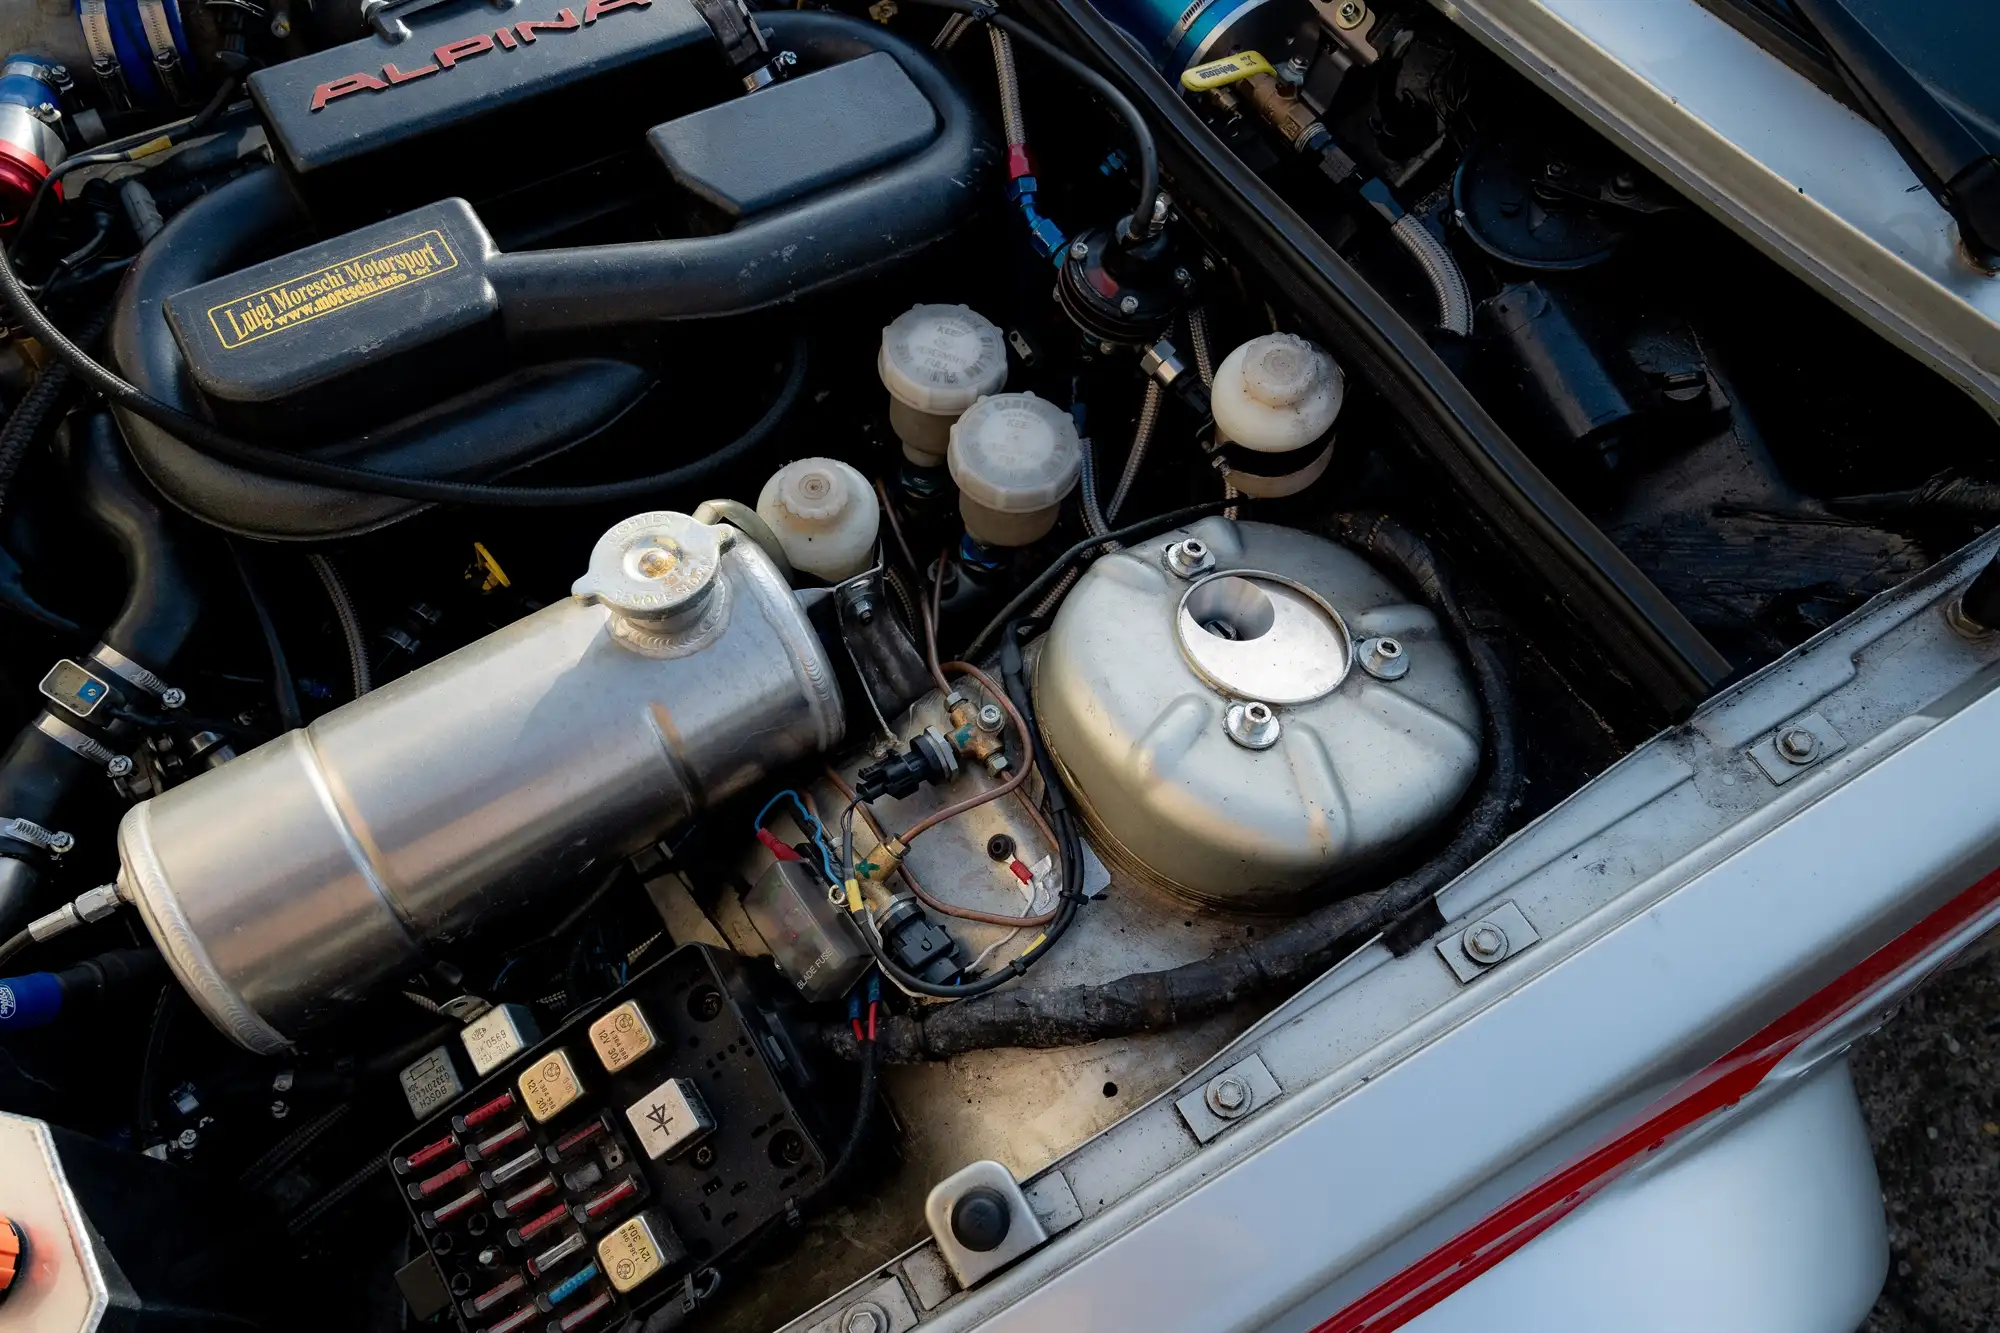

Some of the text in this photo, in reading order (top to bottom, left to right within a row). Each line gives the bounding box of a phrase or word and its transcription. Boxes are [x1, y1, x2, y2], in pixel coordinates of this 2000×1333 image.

[311, 0, 650, 111] ALPINA
[224, 242, 441, 341] Luigi Moreschi Motorsport
[274, 272, 407, 327] www.moreschi.info
[796, 947, 833, 990] BLADE FUSE
[486, 1029, 507, 1048] 0569
[598, 1029, 621, 1065] 12V 30A
[420, 1085, 448, 1109] BOSCH
[527, 1079, 549, 1115] 12V 30A
[628, 1224, 652, 1262] 12V 30A
